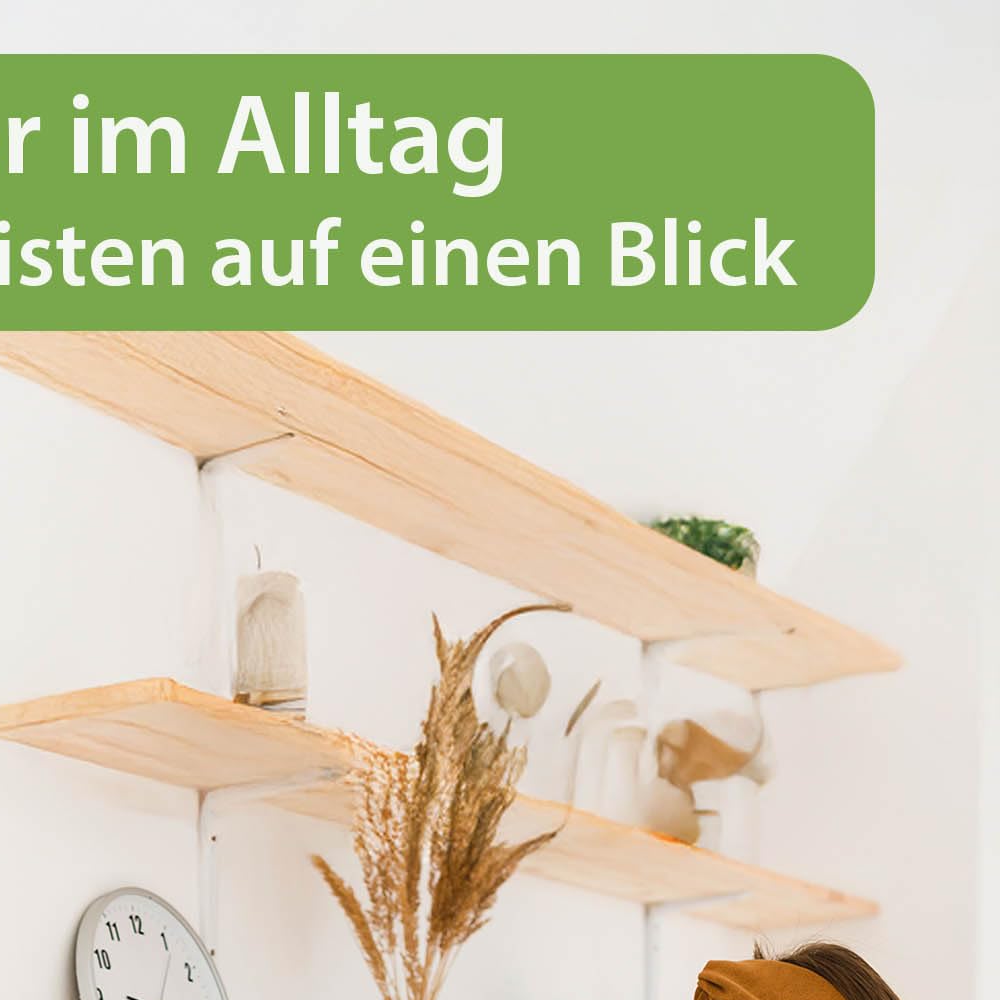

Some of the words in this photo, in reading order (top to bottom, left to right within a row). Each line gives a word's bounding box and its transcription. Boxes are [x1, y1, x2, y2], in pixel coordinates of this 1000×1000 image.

[106, 921, 121, 942] 11
[129, 914, 145, 936] 12
[160, 932, 169, 951] 1
[94, 949, 112, 971] 10
[184, 962, 193, 983] 2
